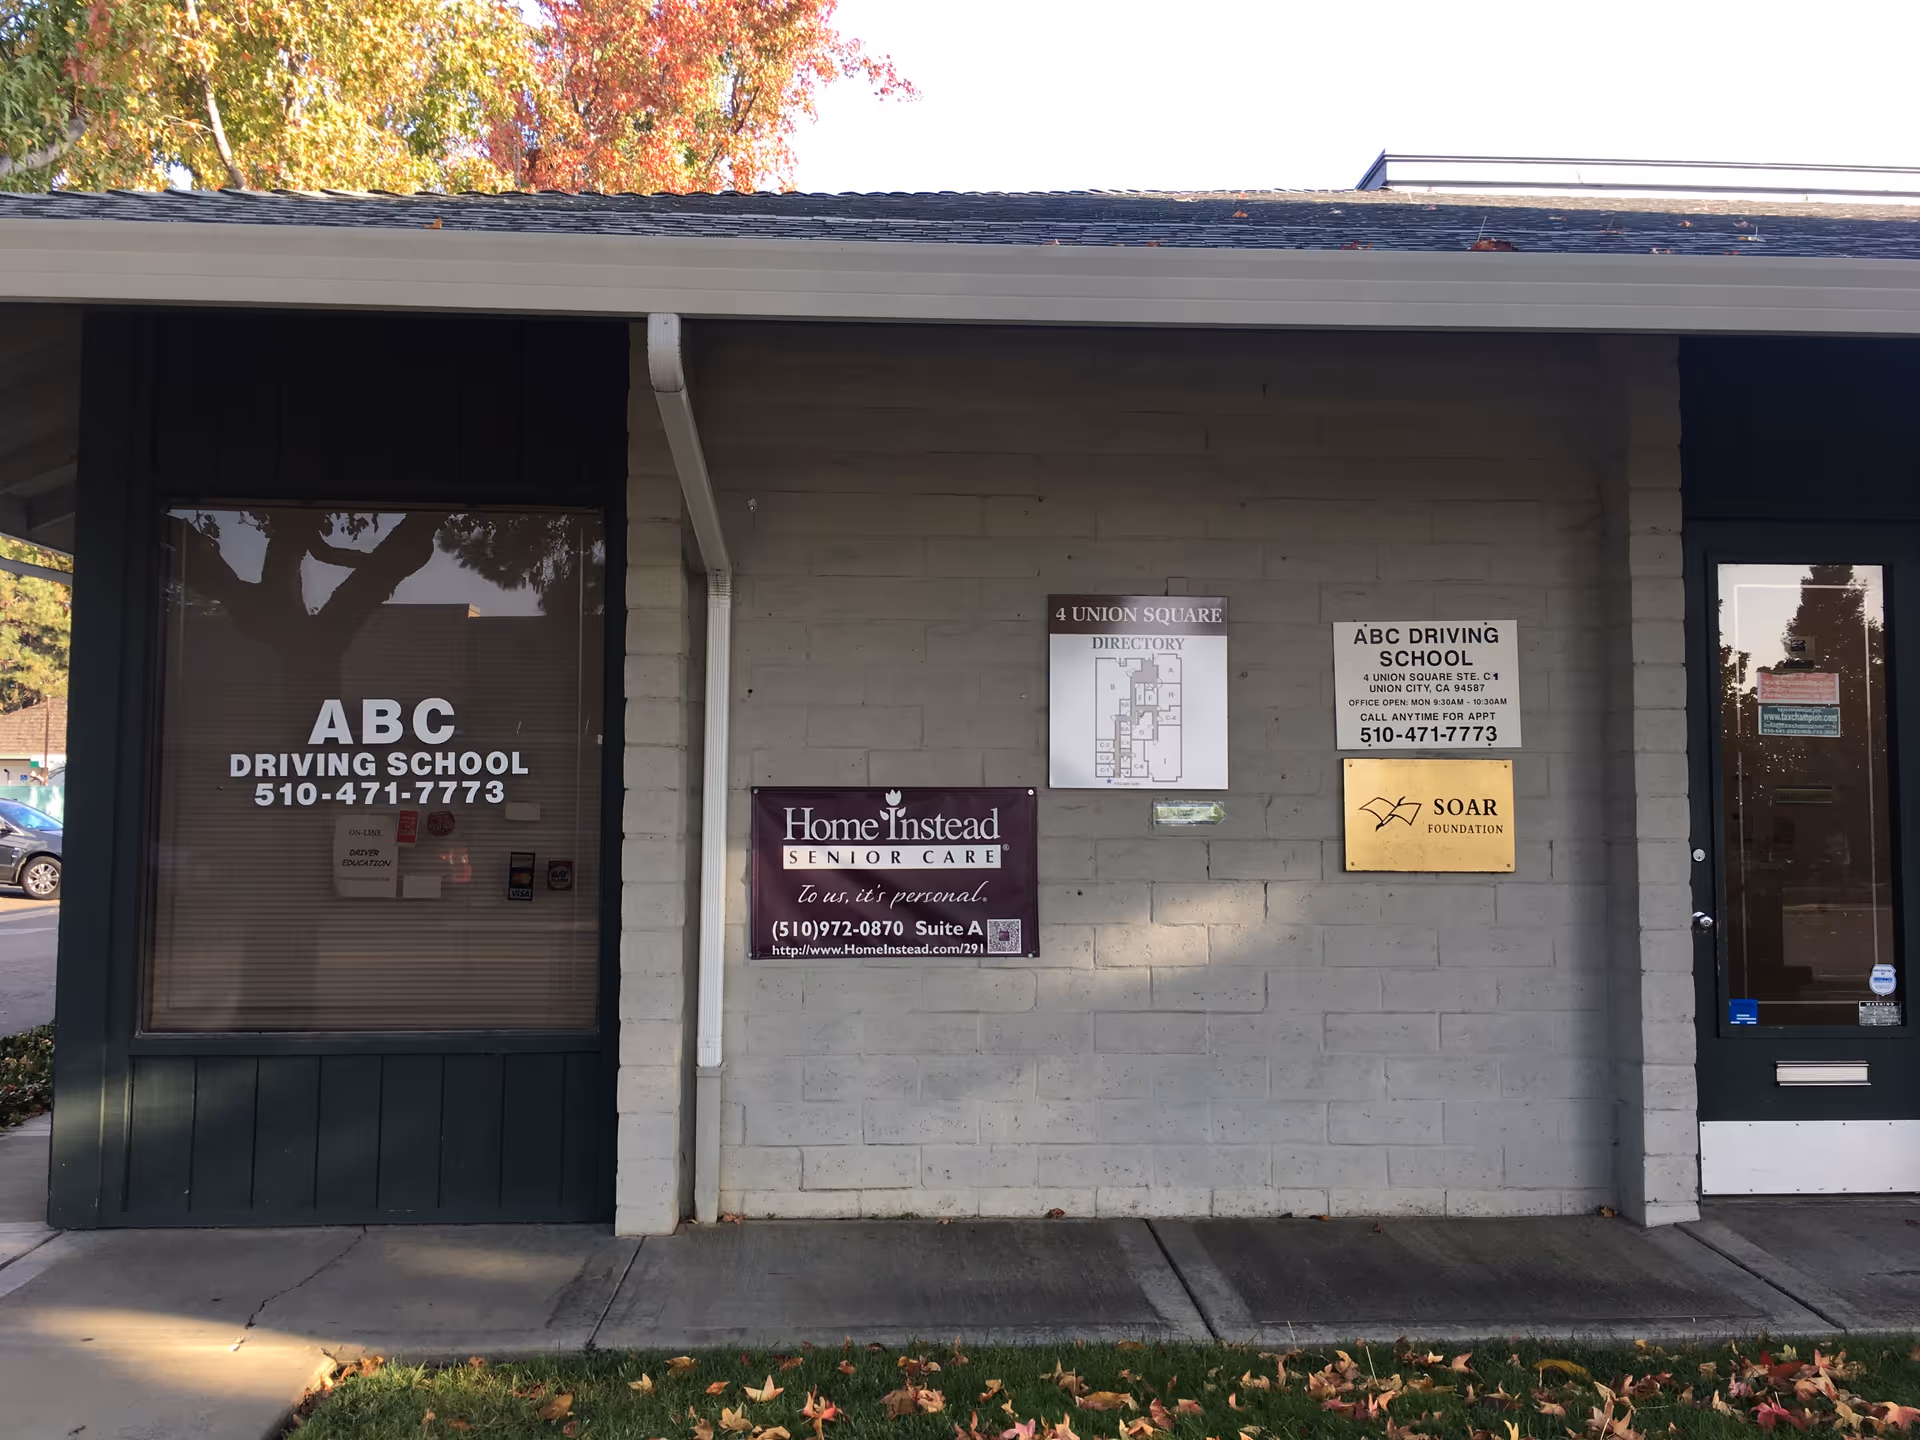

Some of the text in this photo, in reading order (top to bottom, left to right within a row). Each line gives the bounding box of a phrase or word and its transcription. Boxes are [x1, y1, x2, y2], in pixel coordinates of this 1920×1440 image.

[1055, 606, 1222, 625] 4 UNION SQUARE
[1092, 637, 1185, 650] DIRECTORY
[1354, 627, 1499, 645] ABC DRIVING
[1380, 650, 1473, 667] SCHOOL
[1363, 674, 1370, 682] 4
[1373, 673, 1406, 682] UNION
[1409, 673, 1453, 682] SQUARE
[1456, 672, 1480, 681] STE.
[1369, 683, 1485, 694] UNION CITY, CA 94587
[1348, 699, 1380, 707] OFFICE
[1382, 698, 1409, 706] OPEN:
[1411, 698, 1431, 706] MON
[1433, 698, 1464, 706] 9:30AM
[1473, 698, 1508, 706] 10:30AM
[308, 698, 456, 745] ABC
[1360, 712, 1496, 721] CALL ANYTIME FOR APPT
[1360, 725, 1497, 743] 510-471-7773
[230, 751, 528, 778] DRIVING SCHOOL
[254, 780, 505, 806] 510-471-7773
[1433, 798, 1498, 816] SOAR
[783, 807, 1001, 841] Home Instead
[1427, 823, 1504, 834] FOUNDATION
[789, 849, 994, 864] SENIOR CARE
[797, 884, 817, 903] To
[823, 891, 849, 904] us,
[856, 883, 886, 903] it's
[772, 920, 984, 941] (510)972-0870 Suite A
[772, 943, 984, 957] http://www.HomeInstead.com/291
